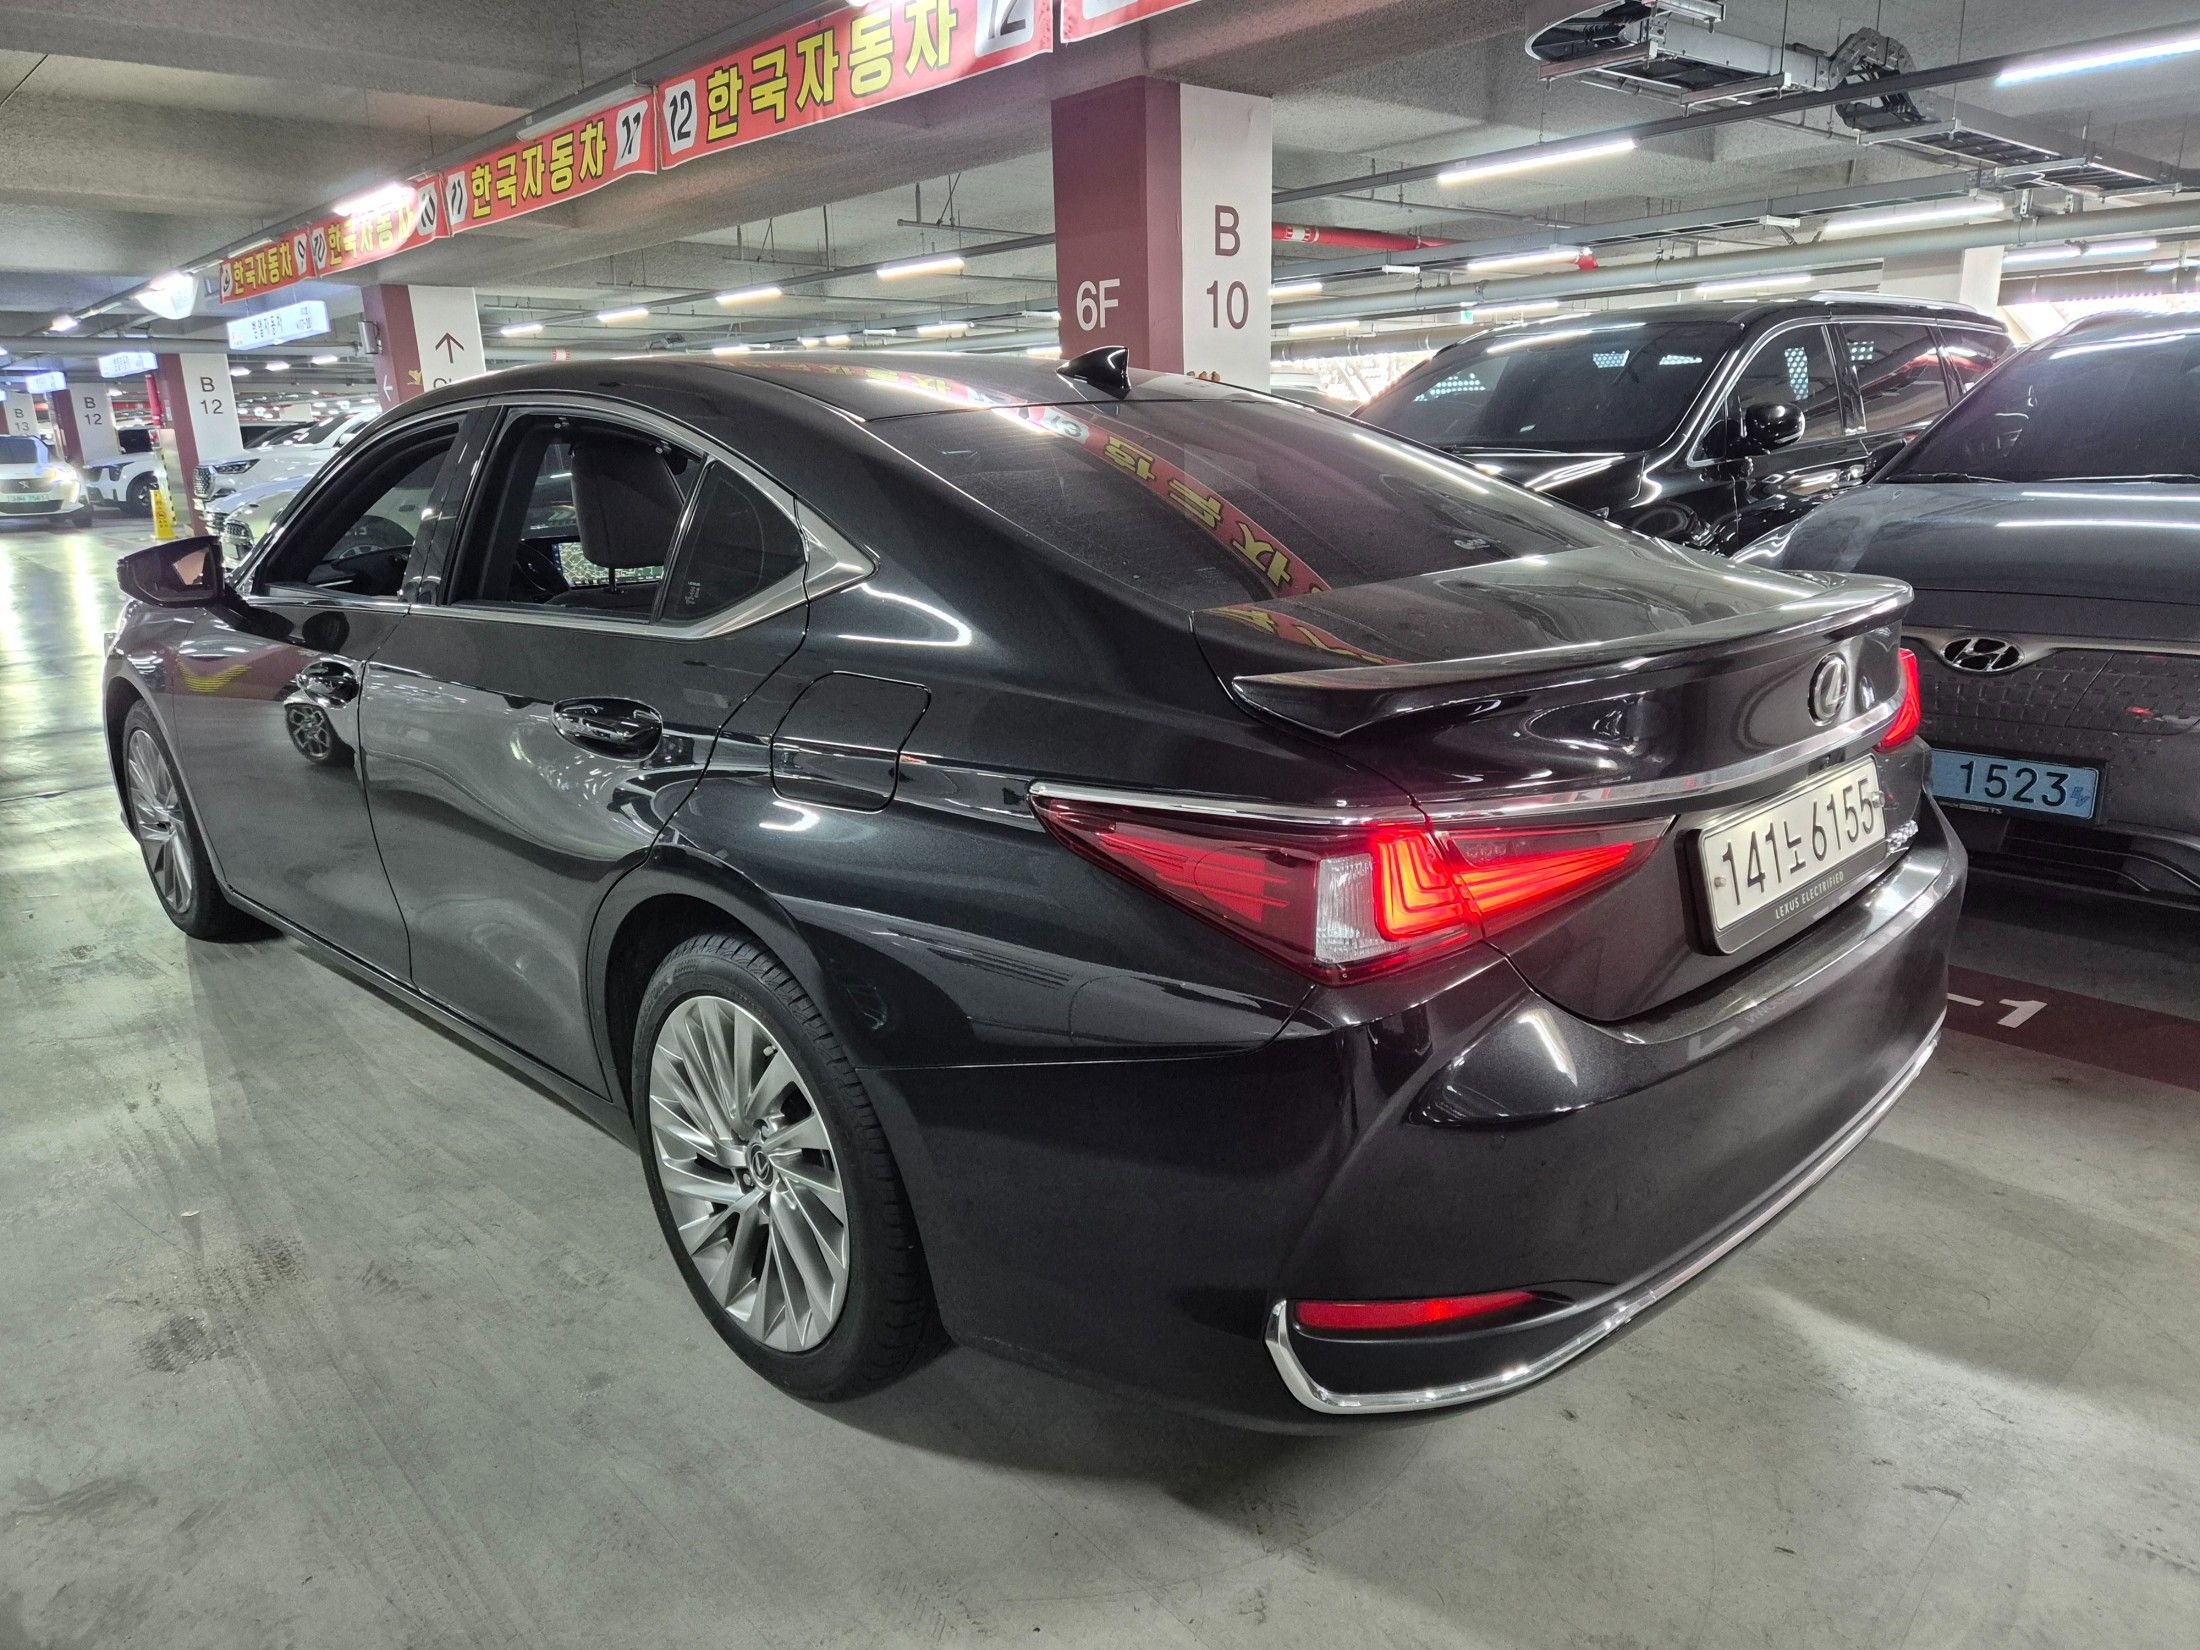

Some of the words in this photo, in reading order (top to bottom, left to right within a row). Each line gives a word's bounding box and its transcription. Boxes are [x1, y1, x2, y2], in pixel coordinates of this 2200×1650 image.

[669, 90, 693, 143] 12
[706, 0, 958, 144] 한국자동차
[451, 179, 464, 217] 11
[470, 121, 606, 218] 한국자동차
[328, 203, 415, 266] 한국자동차
[1215, 205, 1241, 257] B
[233, 240, 293, 296] 한국자동차
[1076, 278, 1121, 332] 6F
[1206, 280, 1250, 330] 10
[84, 397, 96, 409] B
[201, 377, 215, 392] B
[201, 399, 224, 415] 12
[14, 408, 24, 419] B
[14, 421, 30, 432] 13
[84, 413, 103, 426] 12
[1961, 760, 2070, 807] 1523
[1722, 819, 1806, 906] 141노
[1811, 777, 1876, 862] 6155
[1774, 897, 1801, 920] LEXUS
[1802, 871, 1845, 905] ELECTRIFIED
